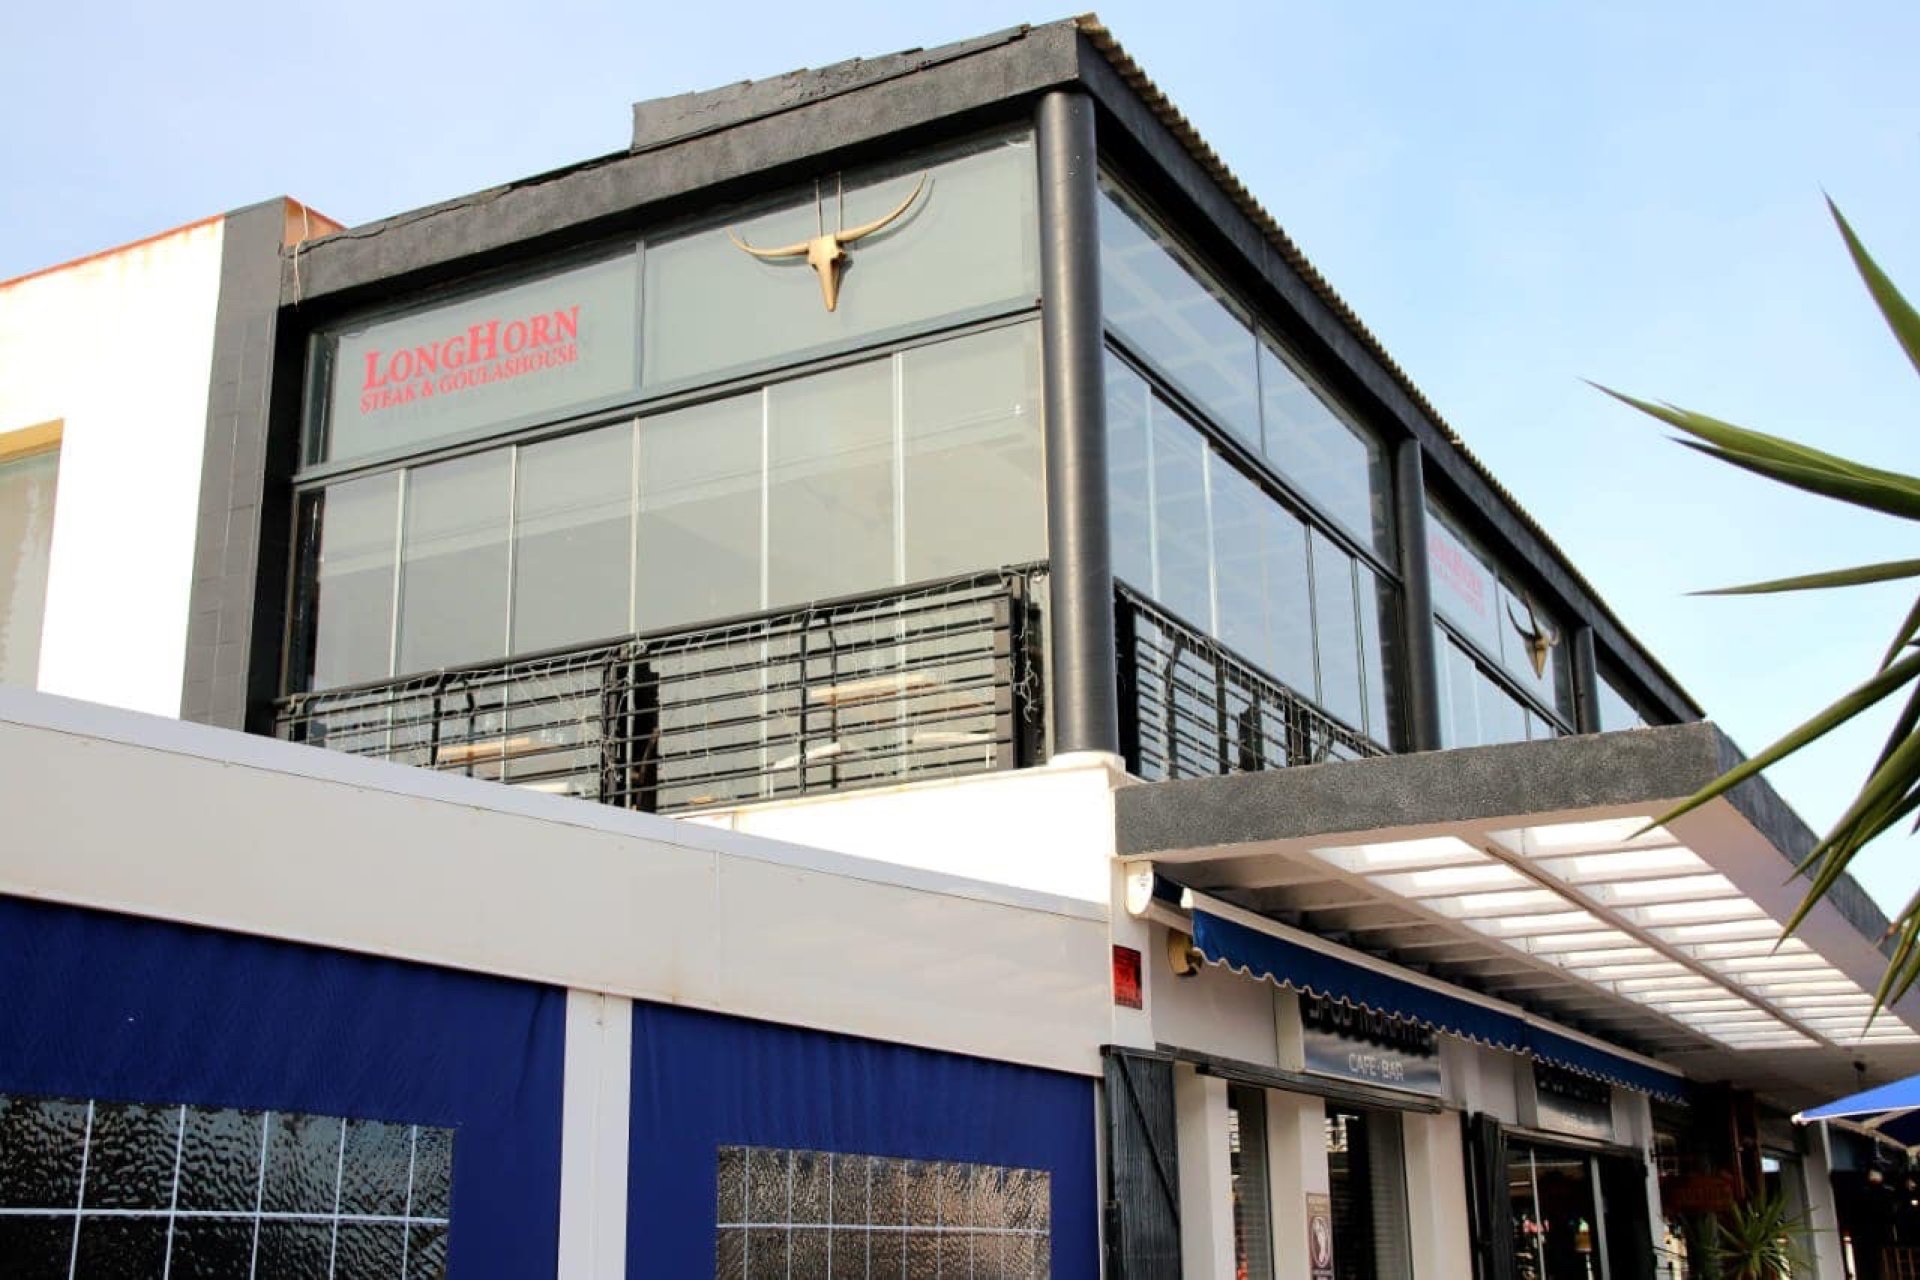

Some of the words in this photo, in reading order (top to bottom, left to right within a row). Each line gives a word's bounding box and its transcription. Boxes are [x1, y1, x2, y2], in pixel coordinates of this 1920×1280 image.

[360, 380, 417, 414] STEAK
[420, 381, 434, 398] &
[439, 343, 578, 395] GOULASHOUSE
[1382, 1058, 1404, 1082] BAR
